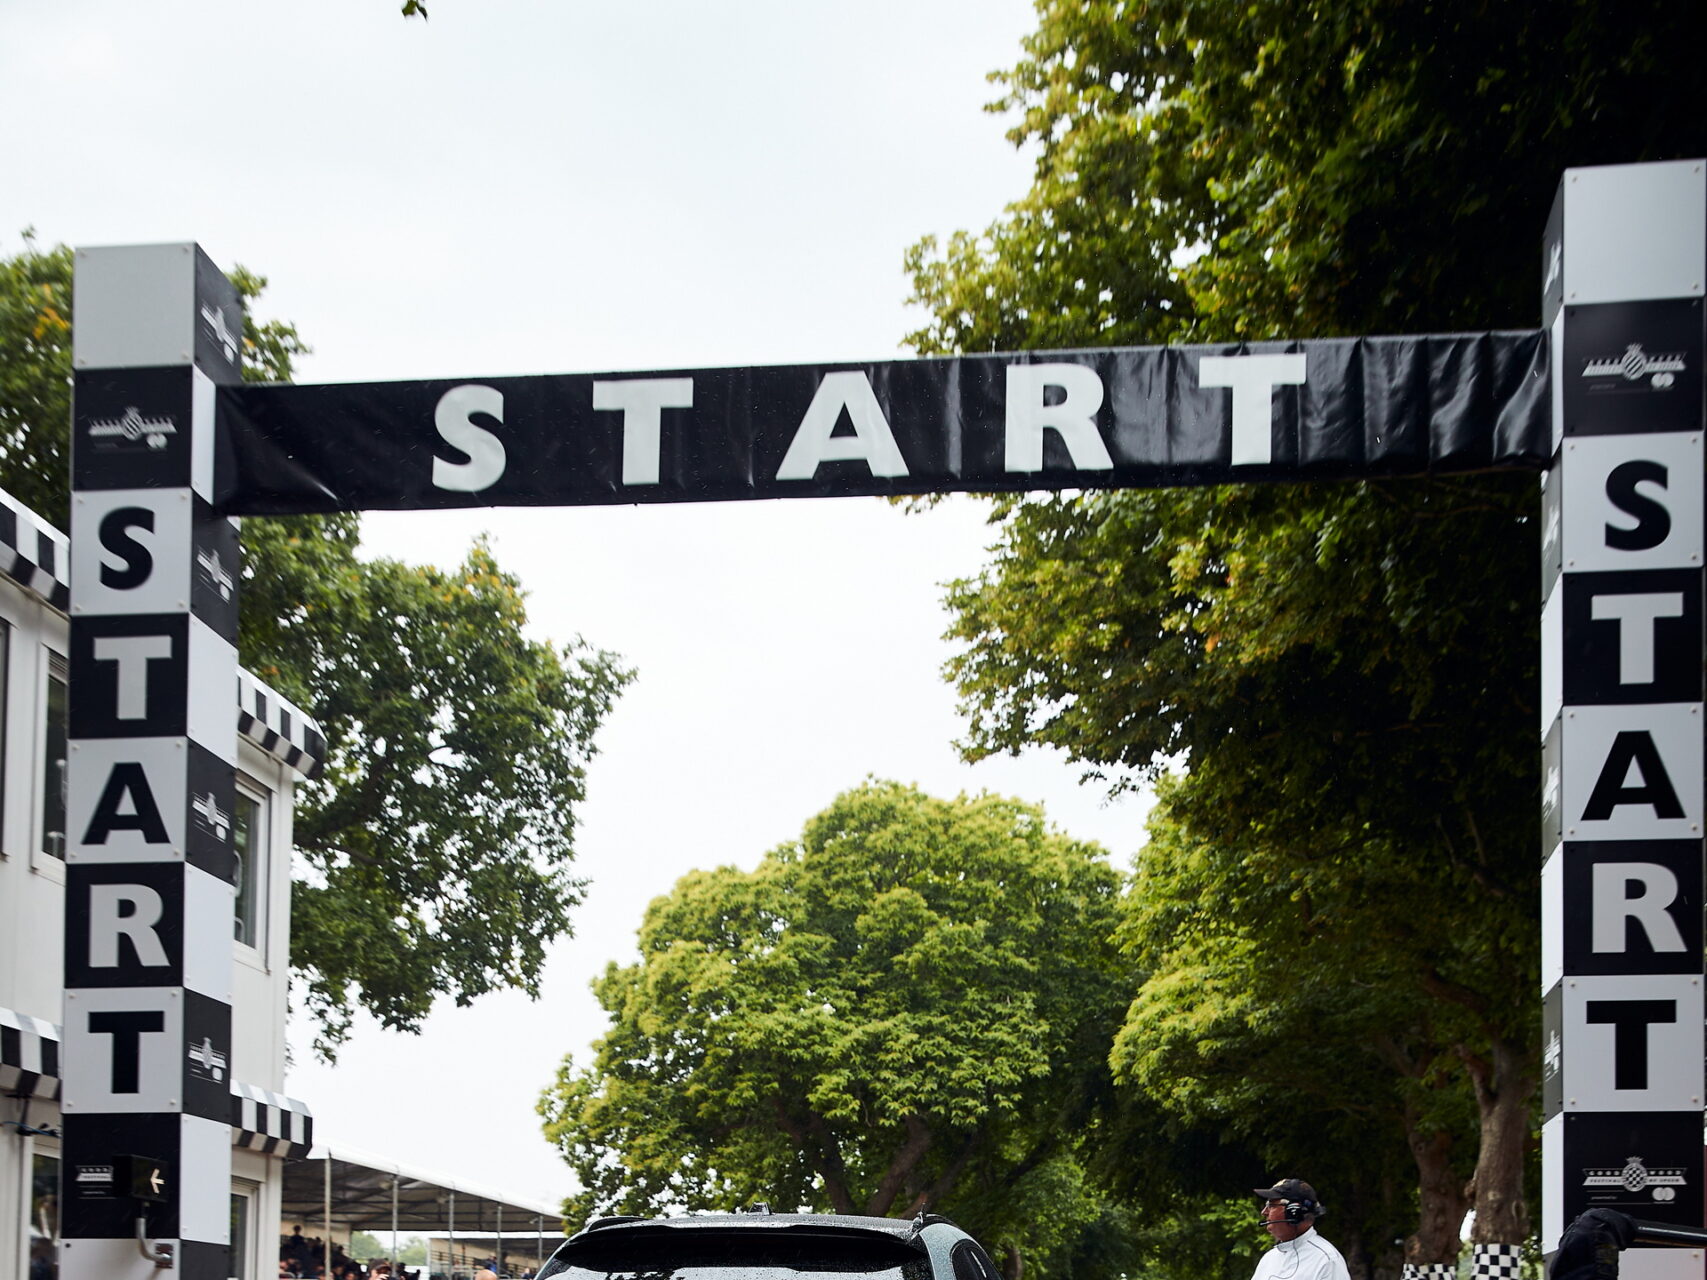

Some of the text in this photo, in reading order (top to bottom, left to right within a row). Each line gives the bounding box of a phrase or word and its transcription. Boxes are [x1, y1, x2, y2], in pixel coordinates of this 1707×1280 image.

[432, 352, 1307, 493] START
[80, 506, 173, 1095] START
[1579, 459, 1688, 1091] START
